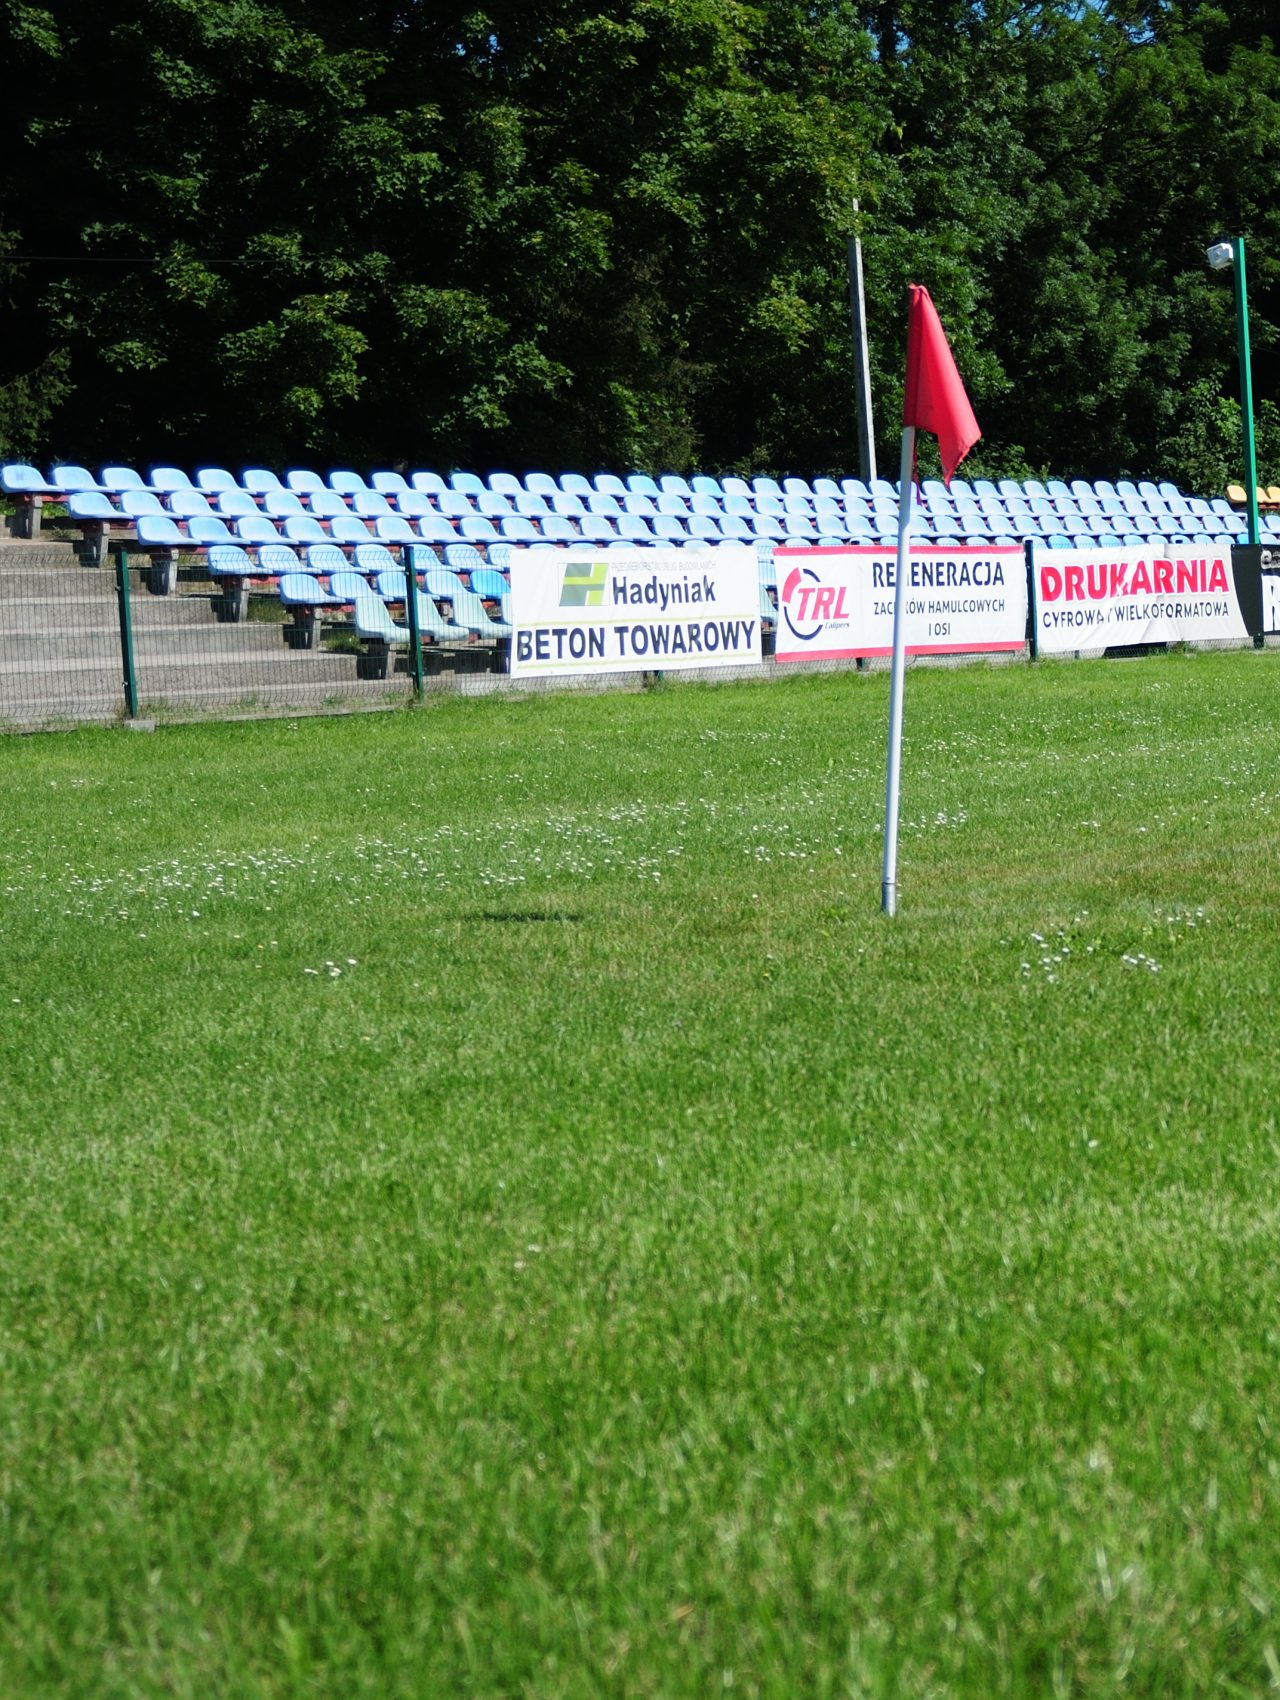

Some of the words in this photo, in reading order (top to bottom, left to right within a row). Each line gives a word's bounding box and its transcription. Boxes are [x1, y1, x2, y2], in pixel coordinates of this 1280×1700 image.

[873, 561, 1005, 588] REENERACJA
[1040, 559, 1229, 602] DRUKARNIA
[612, 574, 716, 611] Hadyniak
[797, 587, 850, 620] TRL
[874, 597, 926, 615] ZACÓW
[928, 599, 1005, 614] HAMULCOWYCH
[1043, 609, 1104, 628] CYFROWA
[1114, 601, 1229, 623] WIELKOFORMATOWA
[517, 628, 605, 661] BETON
[614, 621, 755, 656] TOWAROWY
[928, 623, 931, 637] I
[934, 623, 951, 636] OSI
